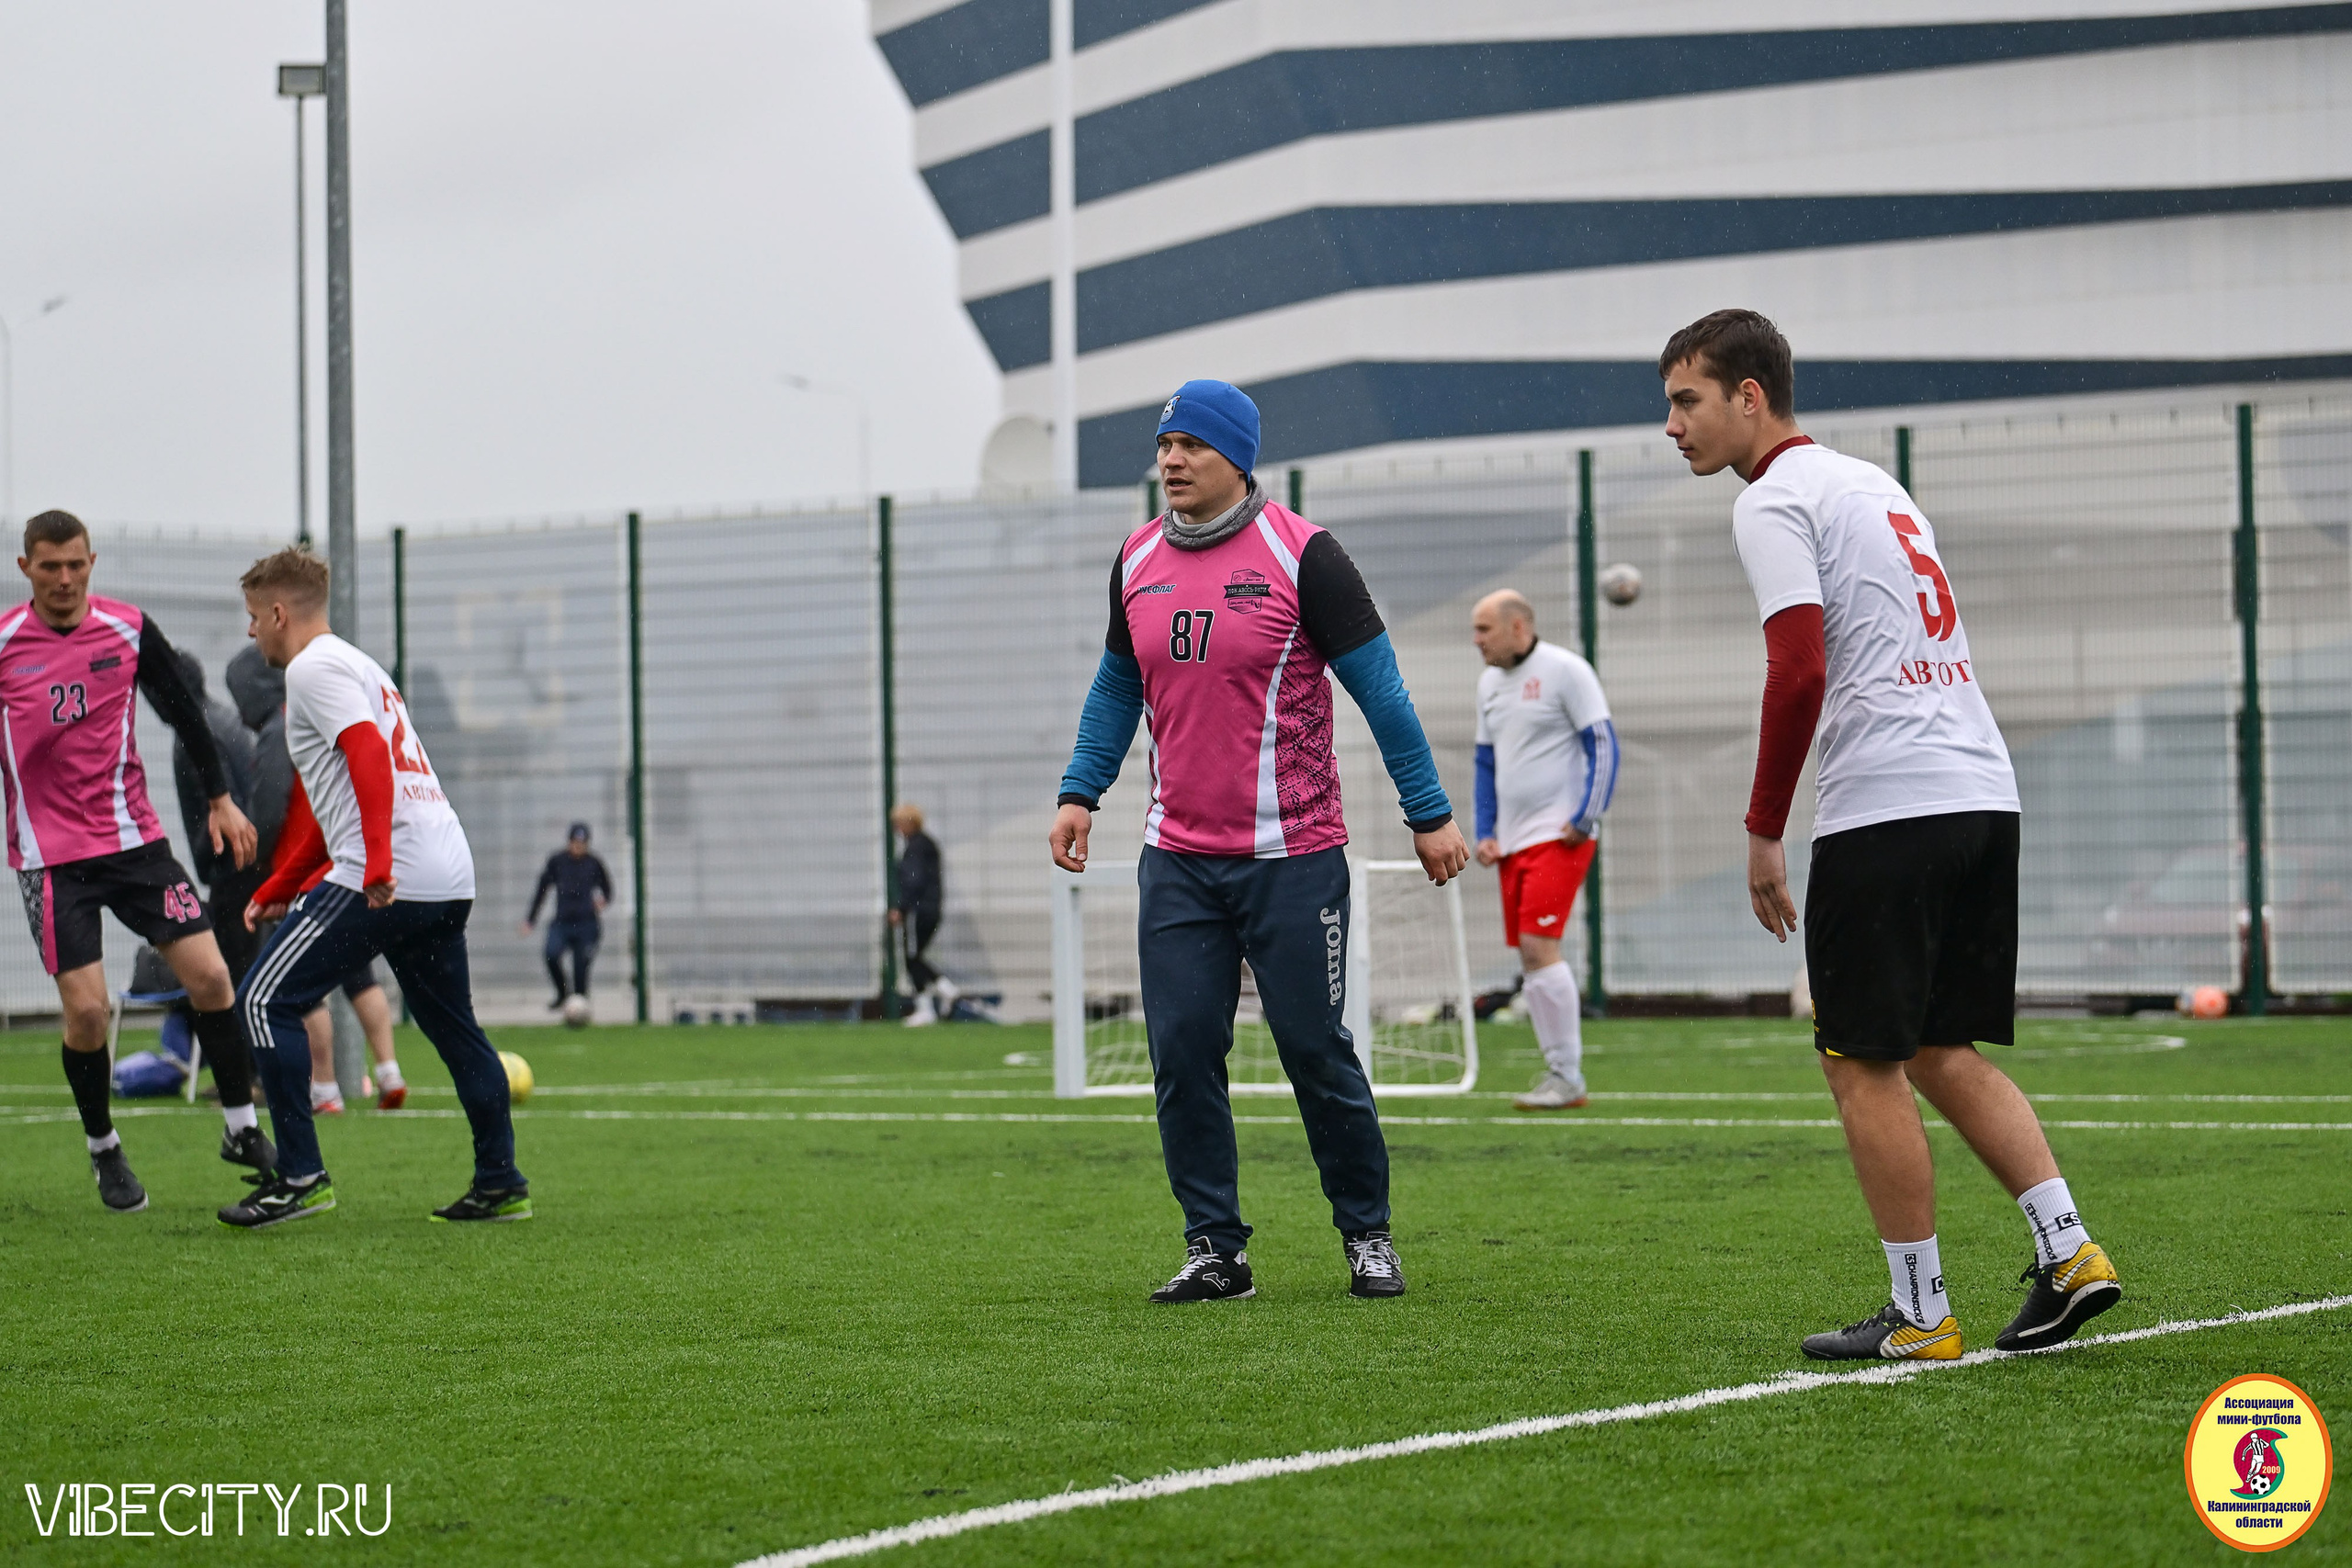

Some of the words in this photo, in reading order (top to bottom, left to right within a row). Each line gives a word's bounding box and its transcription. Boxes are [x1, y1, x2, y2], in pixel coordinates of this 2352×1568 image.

[1886, 510, 1957, 642] 5
[1169, 609, 1216, 663] 87
[50, 682, 89, 725] 23
[164, 881, 202, 924] 45
[1319, 907, 1342, 1007] Joma
[2058, 1213, 2083, 1228] CS
